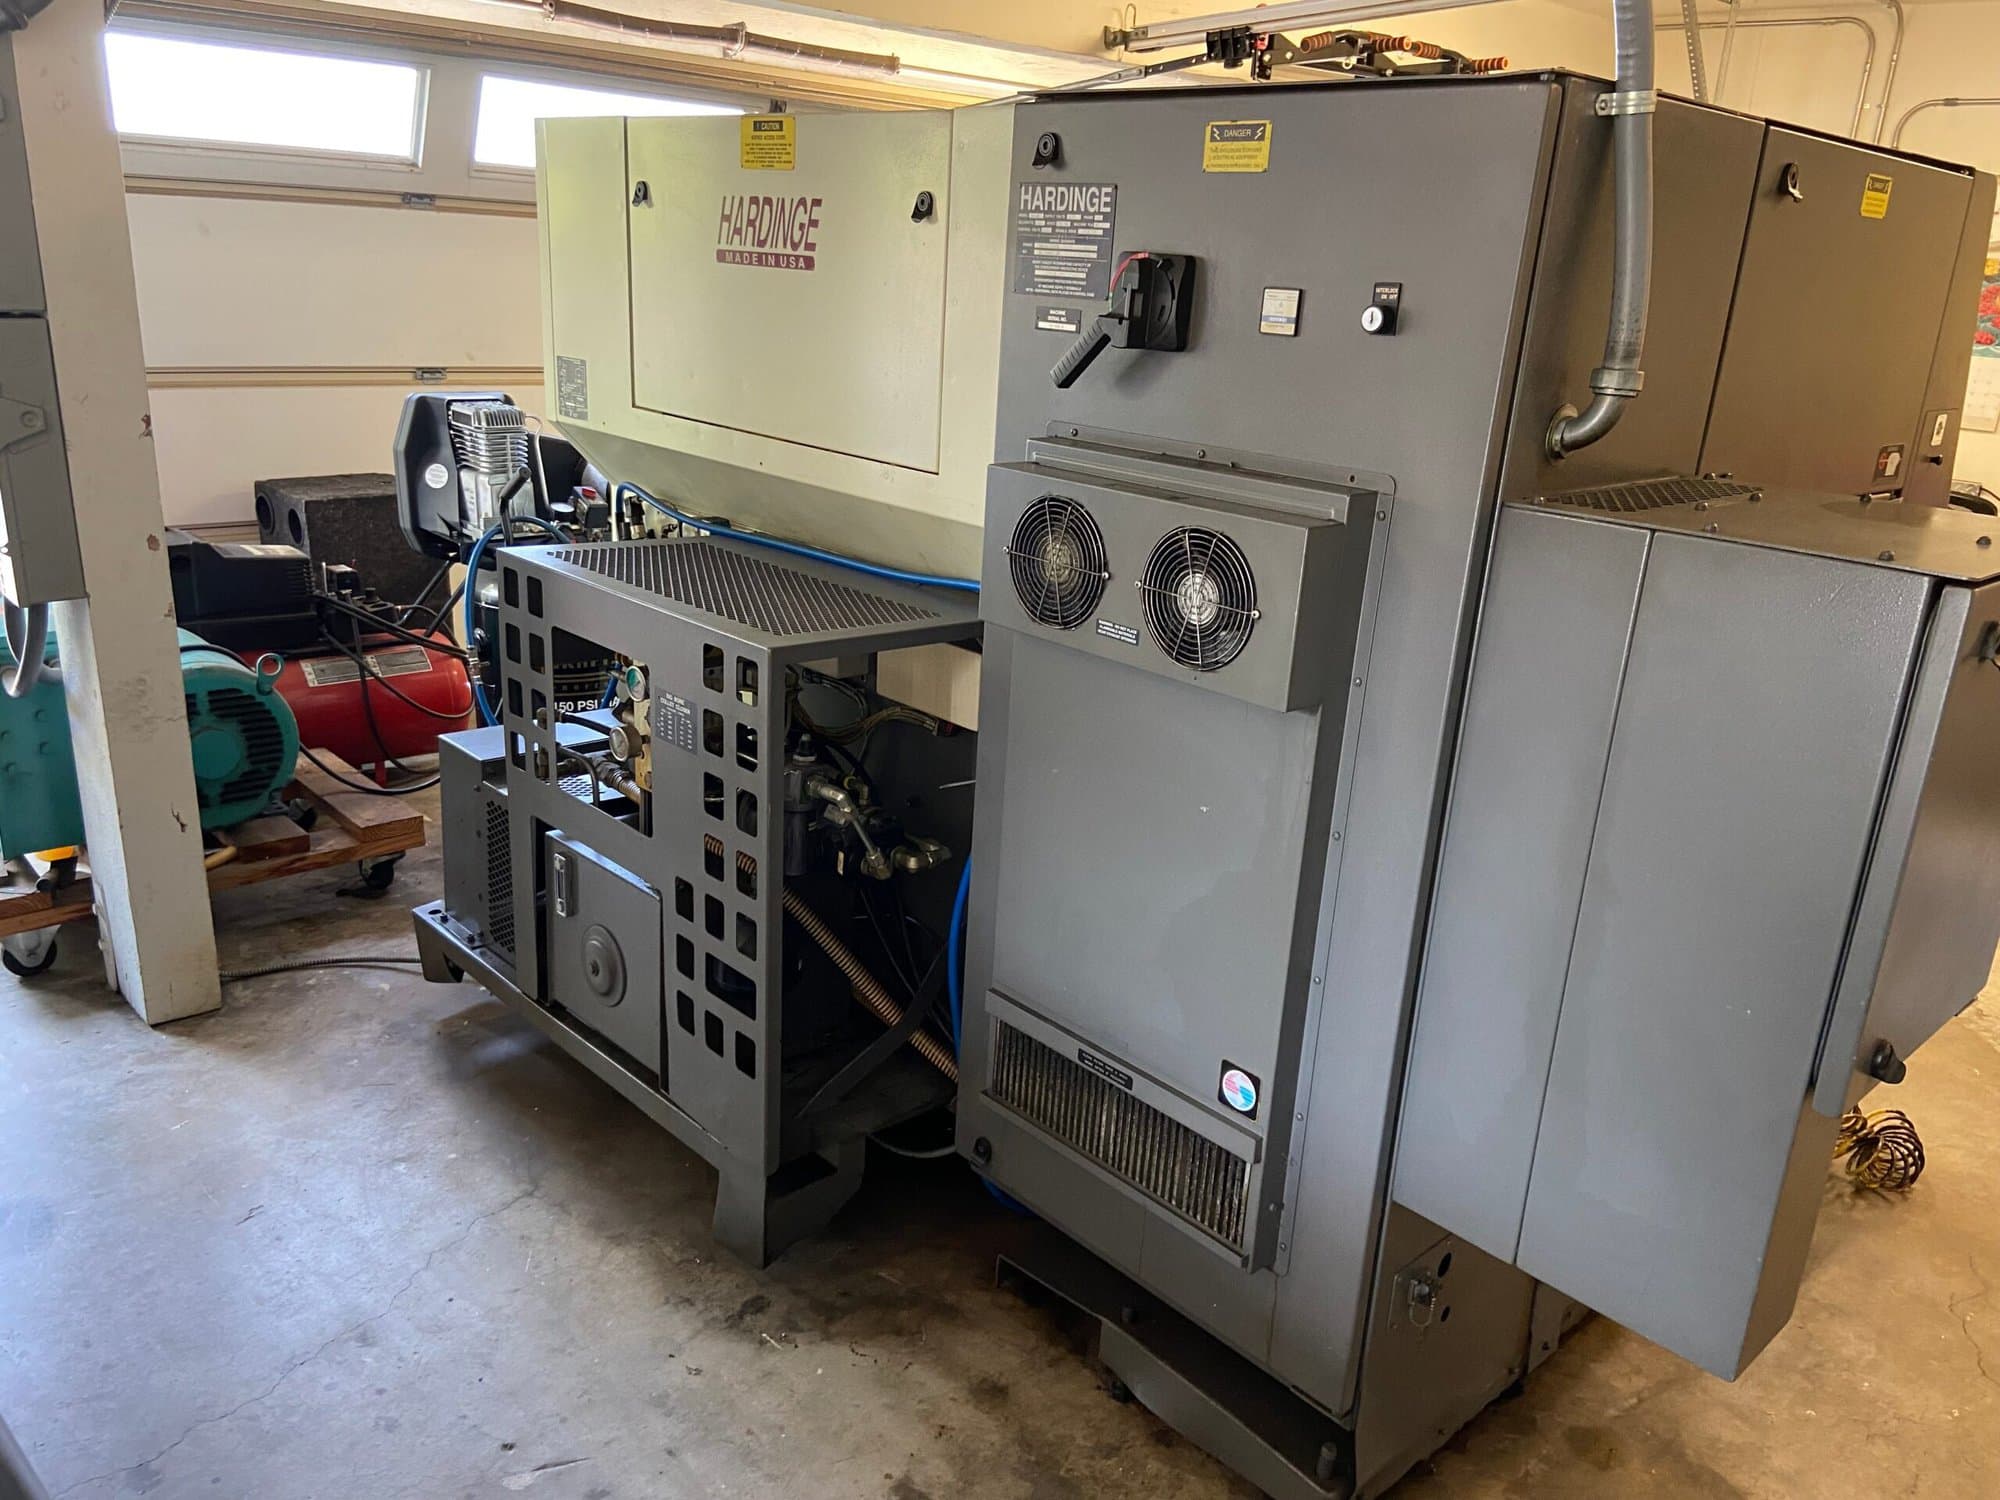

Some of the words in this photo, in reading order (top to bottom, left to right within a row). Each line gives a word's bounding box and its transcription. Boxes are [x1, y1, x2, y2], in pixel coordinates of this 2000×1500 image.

[1223, 129, 1252, 138] DANGER
[1020, 186, 1113, 212] HARDINGE
[717, 195, 823, 252] HARDINGE
[725, 251, 759, 265] MADE
[762, 254, 776, 266] IN
[780, 255, 806, 269] USA
[577, 699, 599, 711] PSI
